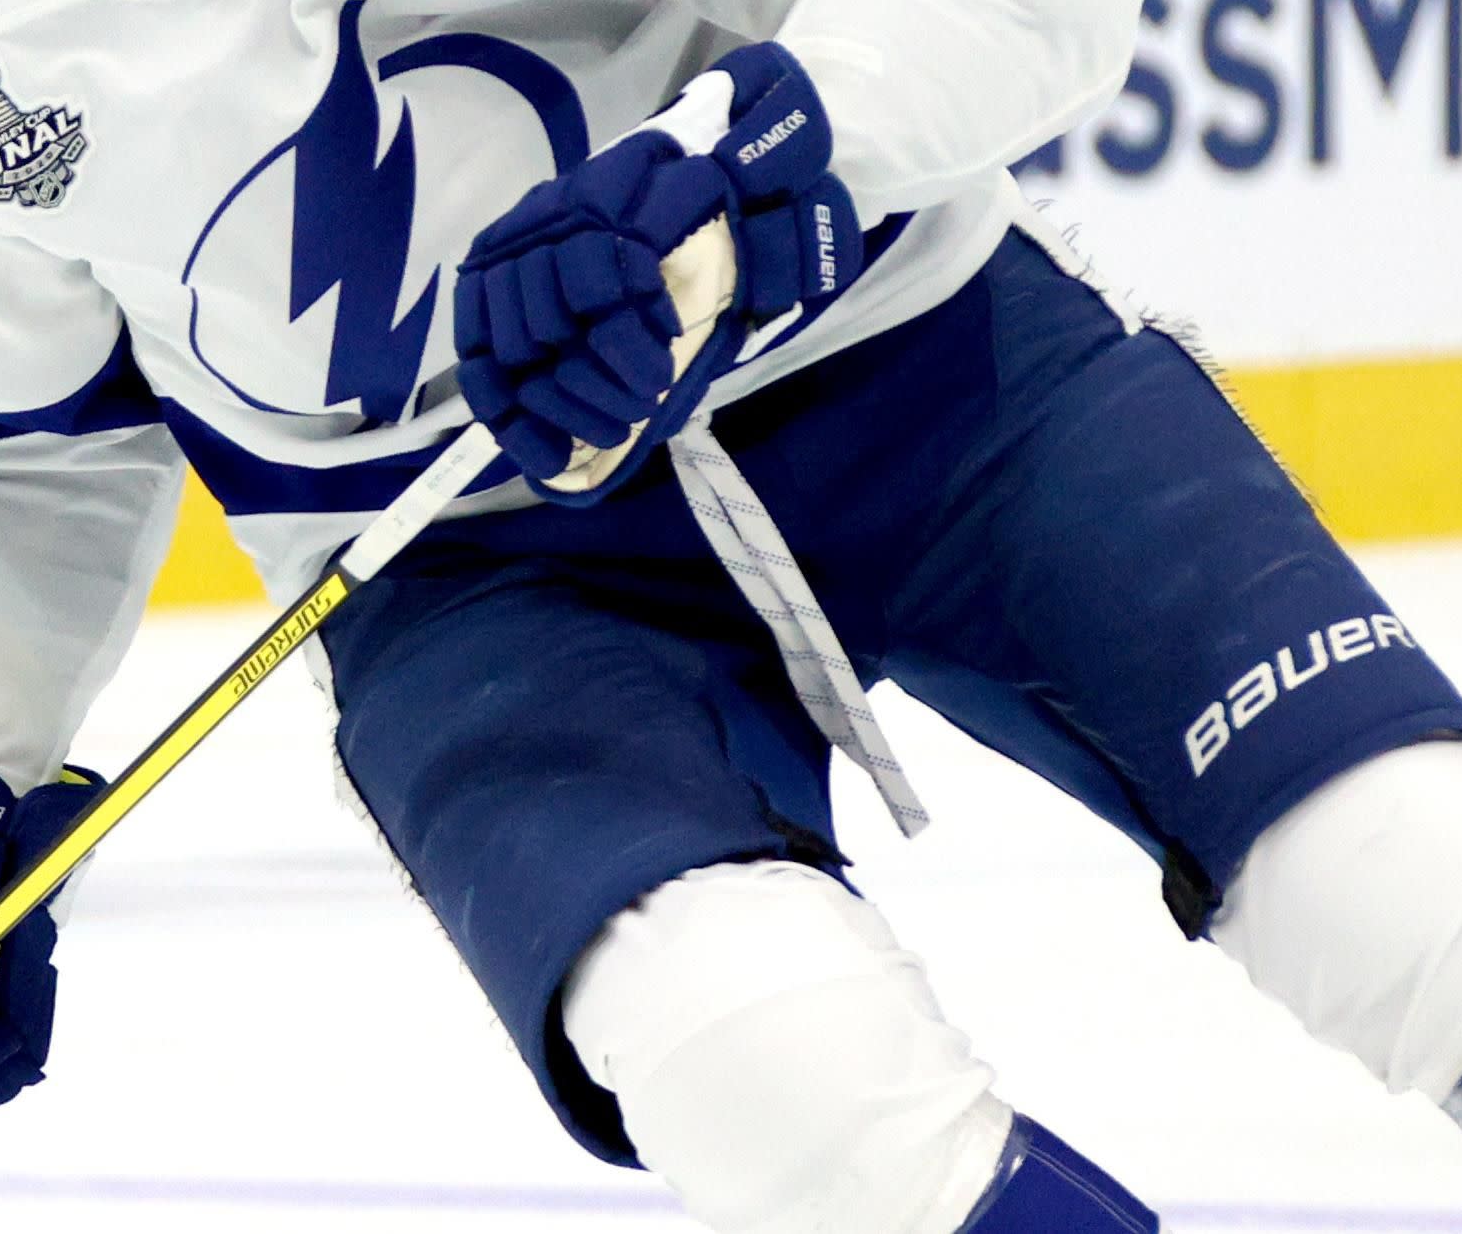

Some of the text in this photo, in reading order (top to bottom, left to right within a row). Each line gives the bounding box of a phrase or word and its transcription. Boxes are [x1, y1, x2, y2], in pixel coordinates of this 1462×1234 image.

[738, 108, 808, 165] STAMKOS
[813, 203, 836, 292] BAUER
[229, 586, 332, 698] SUPREME
[1185, 613, 1415, 778] BAUER
